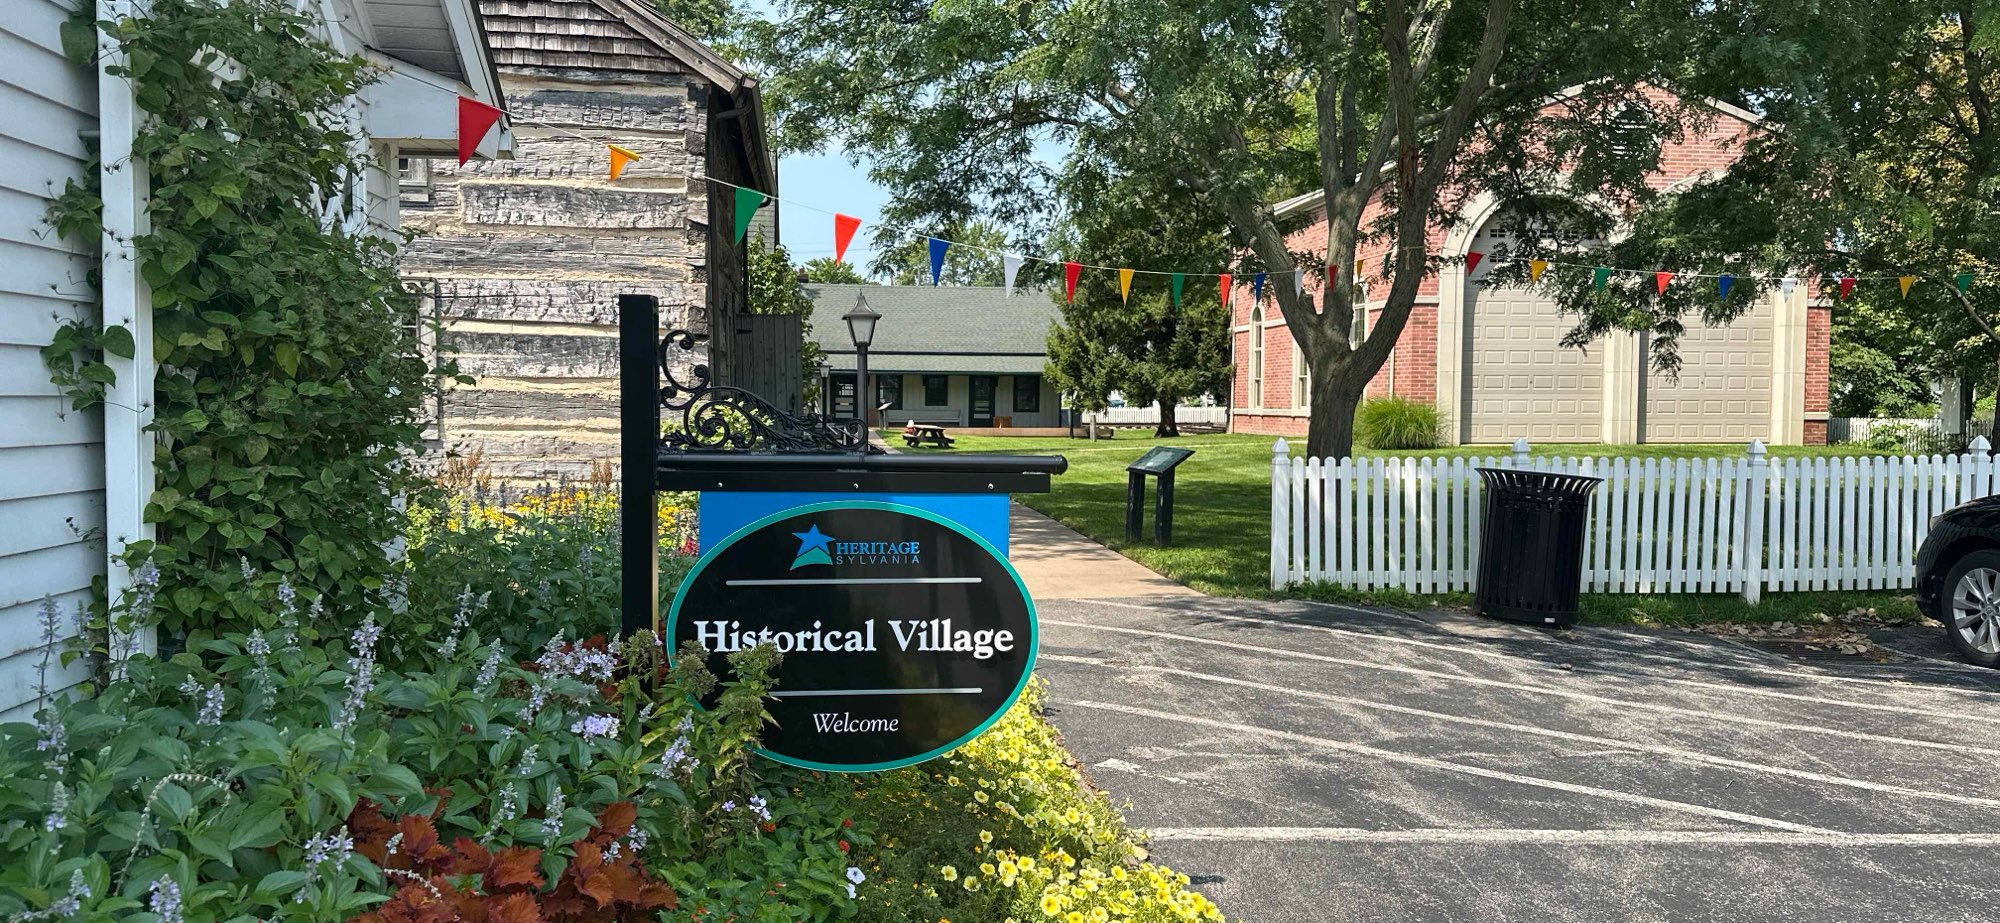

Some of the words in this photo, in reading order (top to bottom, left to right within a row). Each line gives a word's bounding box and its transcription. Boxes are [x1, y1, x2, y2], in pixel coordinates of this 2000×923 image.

[836, 541, 920, 555] HERITAGE
[836, 555, 920, 565] SYLVANIA
[693, 619, 877, 653] Historical
[888, 618, 1014, 659] Village
[813, 712, 899, 733] Welcome
